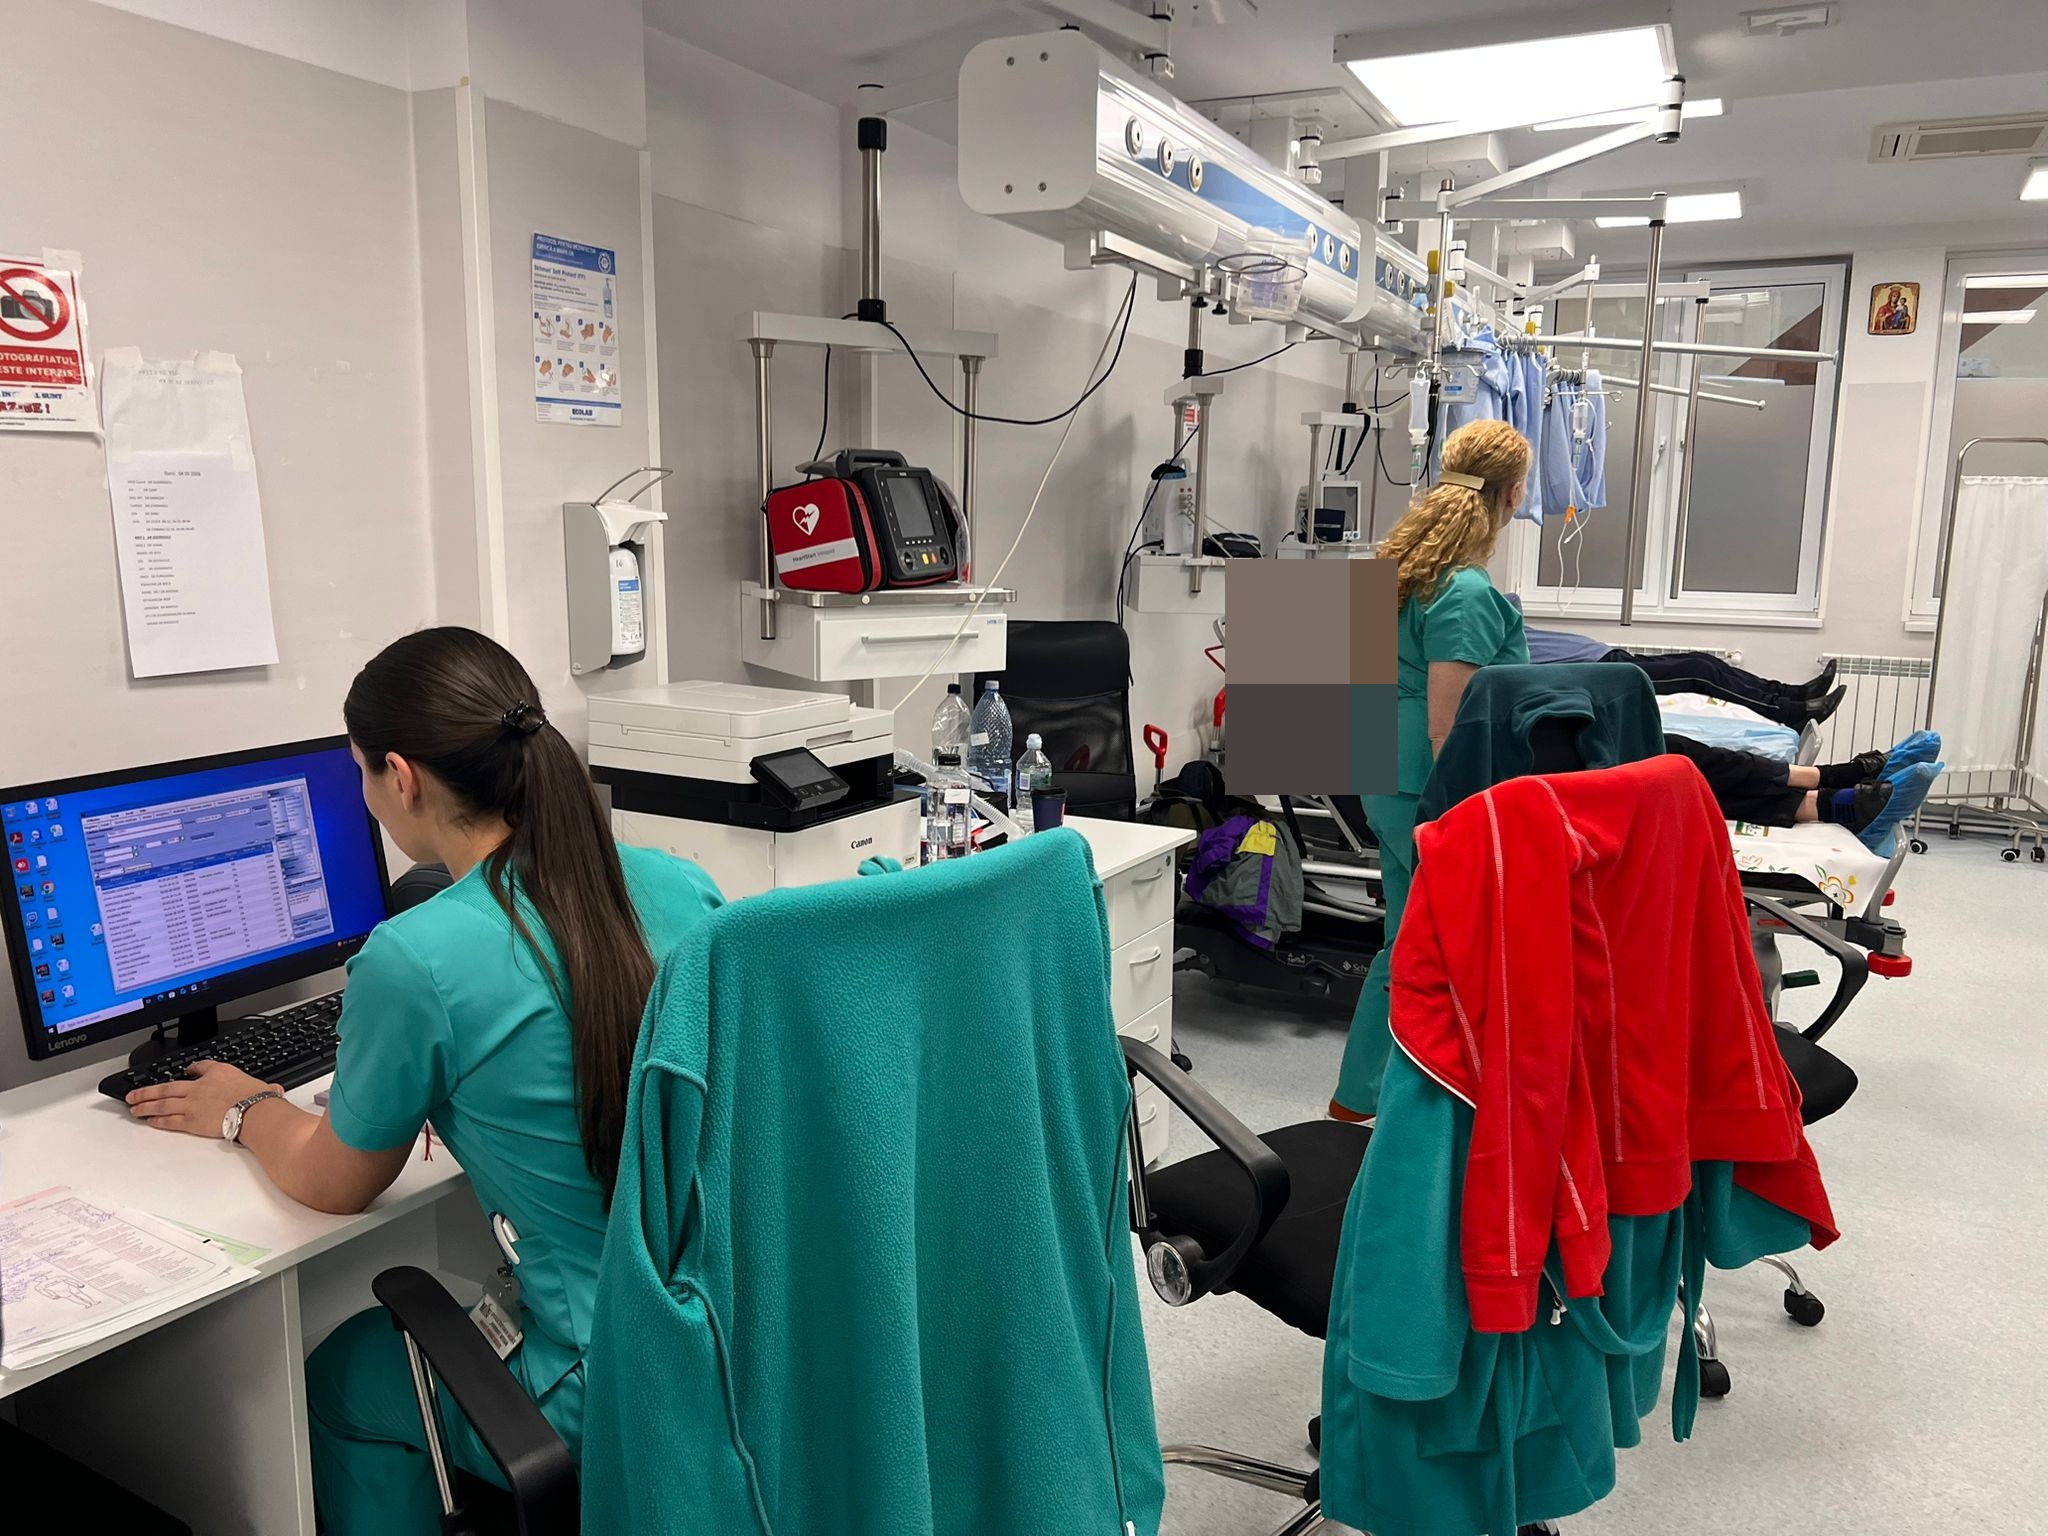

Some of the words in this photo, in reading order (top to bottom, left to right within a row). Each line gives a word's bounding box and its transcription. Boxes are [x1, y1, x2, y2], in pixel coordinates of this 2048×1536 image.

[25, 366, 74, 377] INTERZIS
[572, 408, 593, 416] ECOLAB
[850, 837, 873, 850] Canon
[48, 1034, 87, 1051] Lenovo
